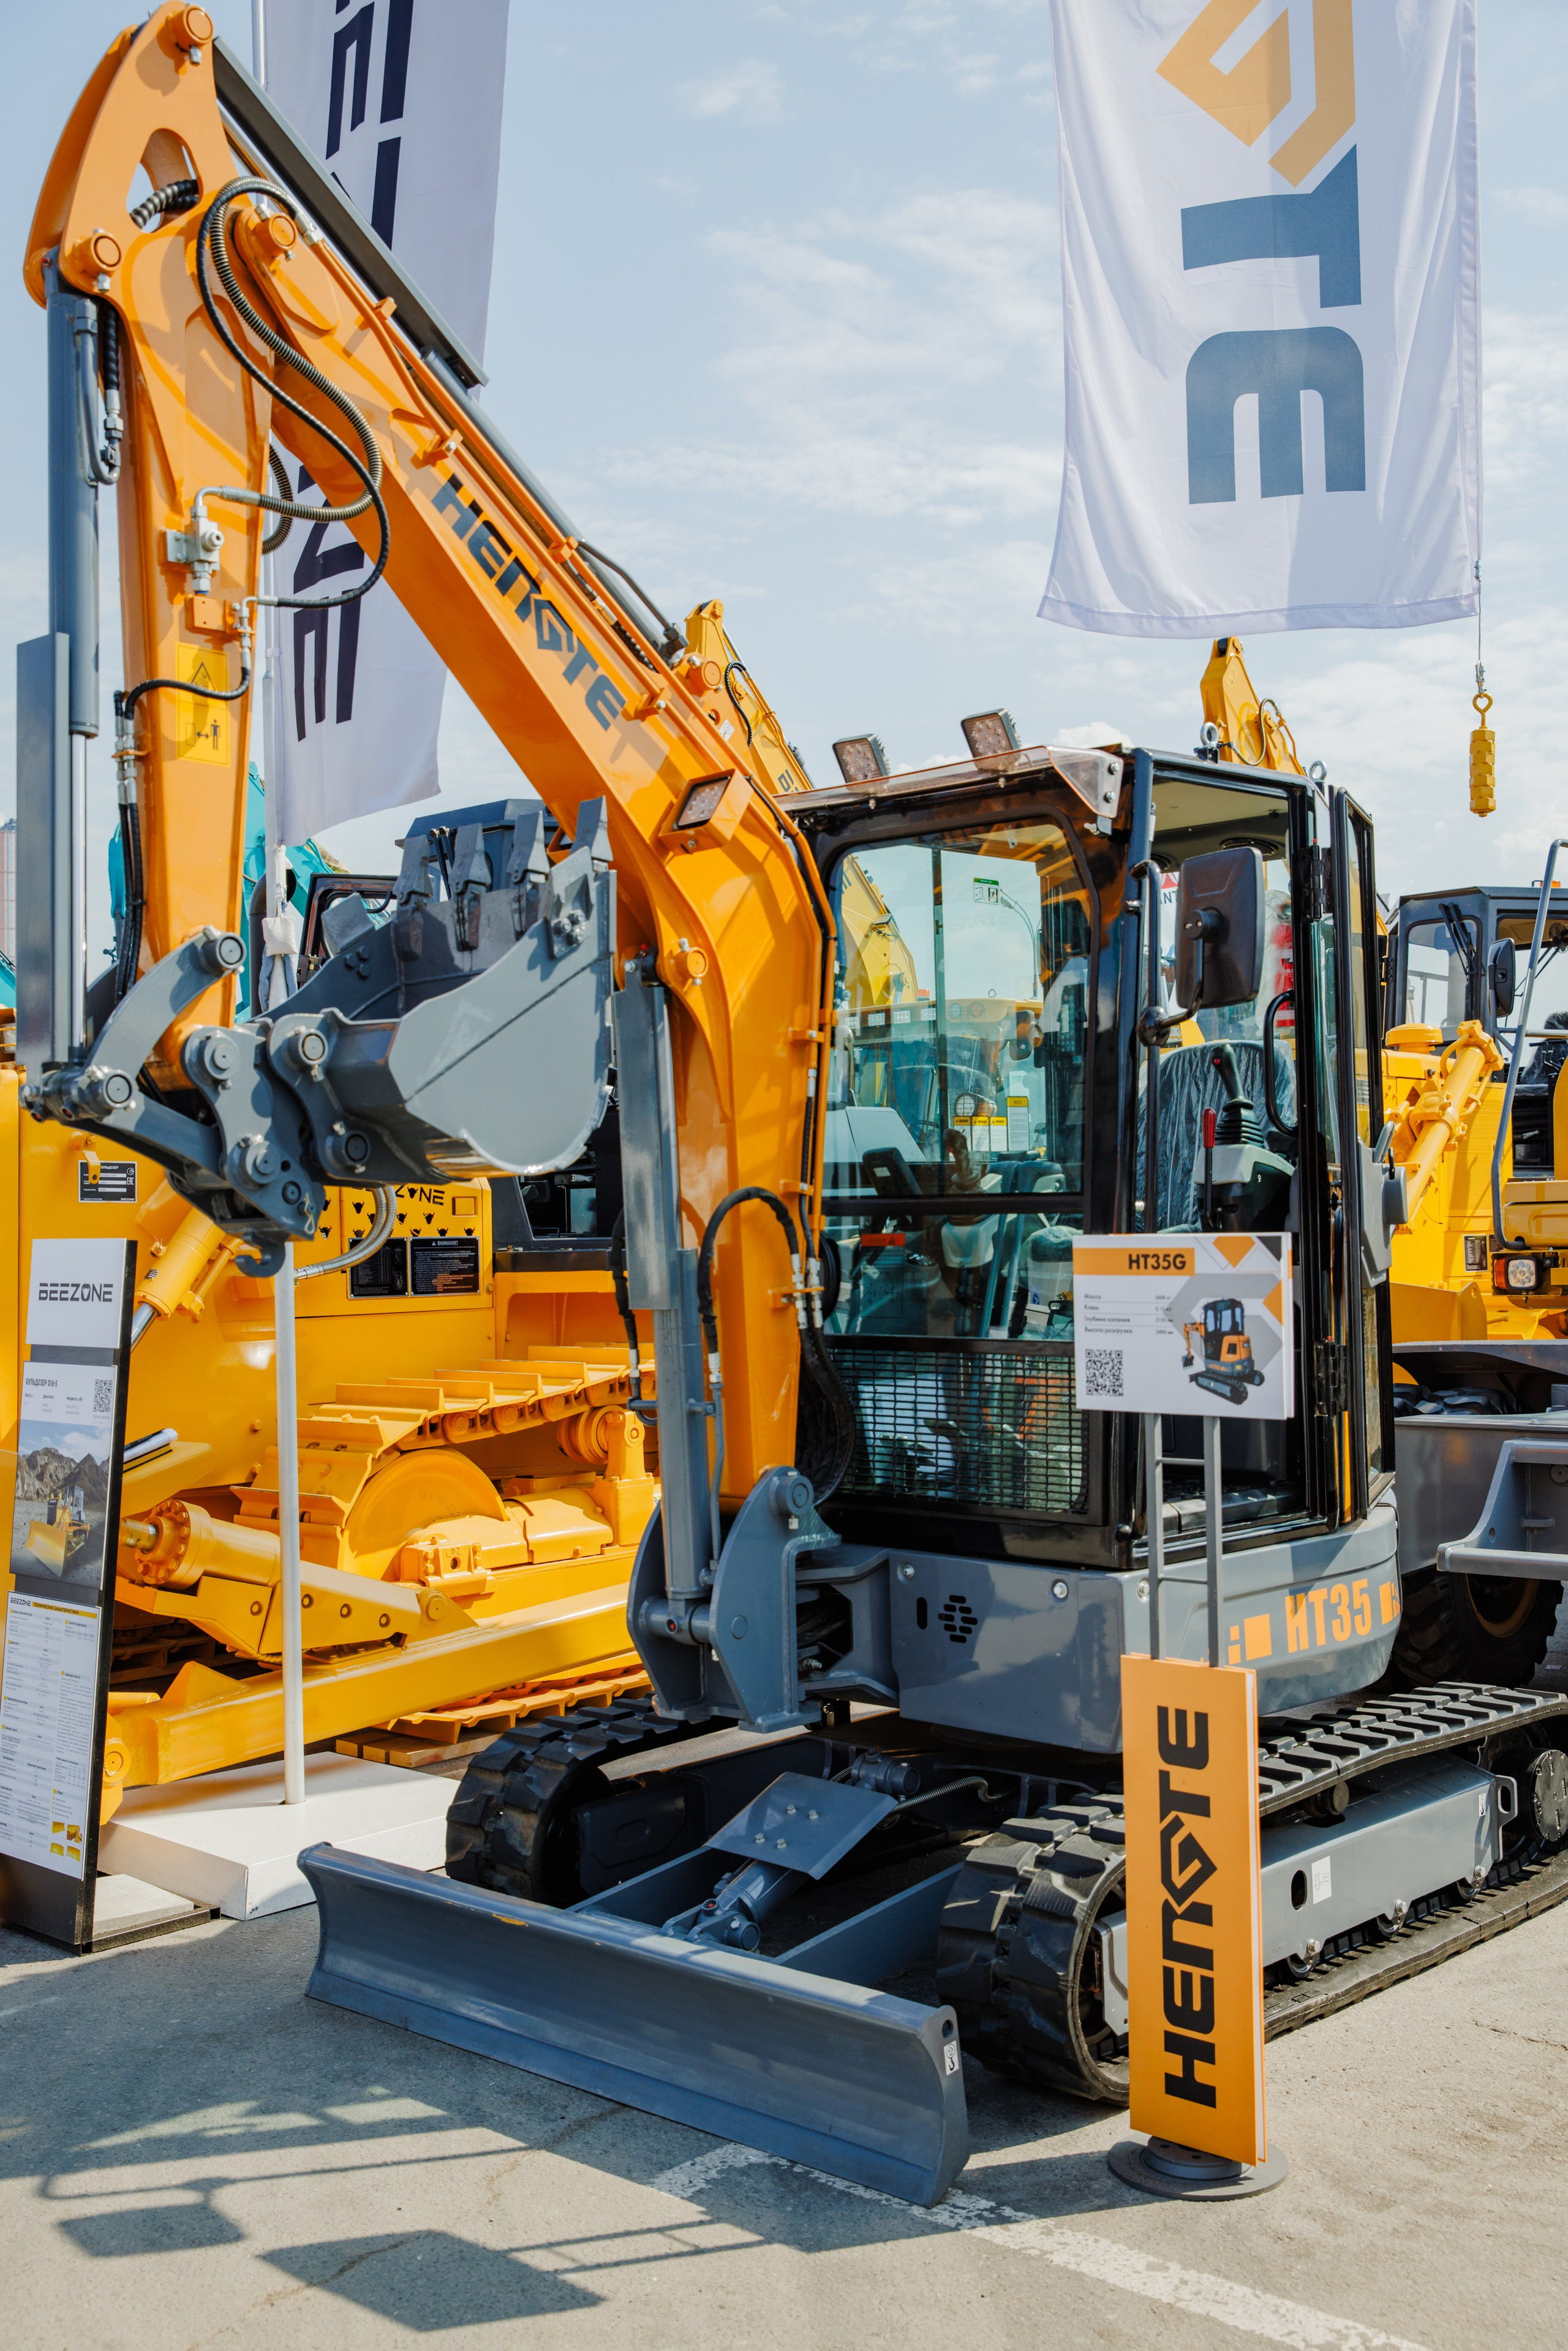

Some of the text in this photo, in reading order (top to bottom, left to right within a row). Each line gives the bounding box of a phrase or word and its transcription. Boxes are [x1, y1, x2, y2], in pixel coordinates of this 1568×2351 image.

[431, 472, 625, 731] HENGTE
[1128, 1254, 1186, 1270] HT35G
[39, 1283, 113, 1302] BEEZONE
[26, 1378, 47, 1387] БУЛЬДОЗЕР
[10, 1597, 31, 1606] BEEZONE
[53, 1606, 79, 1615] ХАРАКТЕРИСТИКИ
[1284, 1578, 1371, 1653] HT35
[1157, 1705, 1218, 2109] HENGTE
